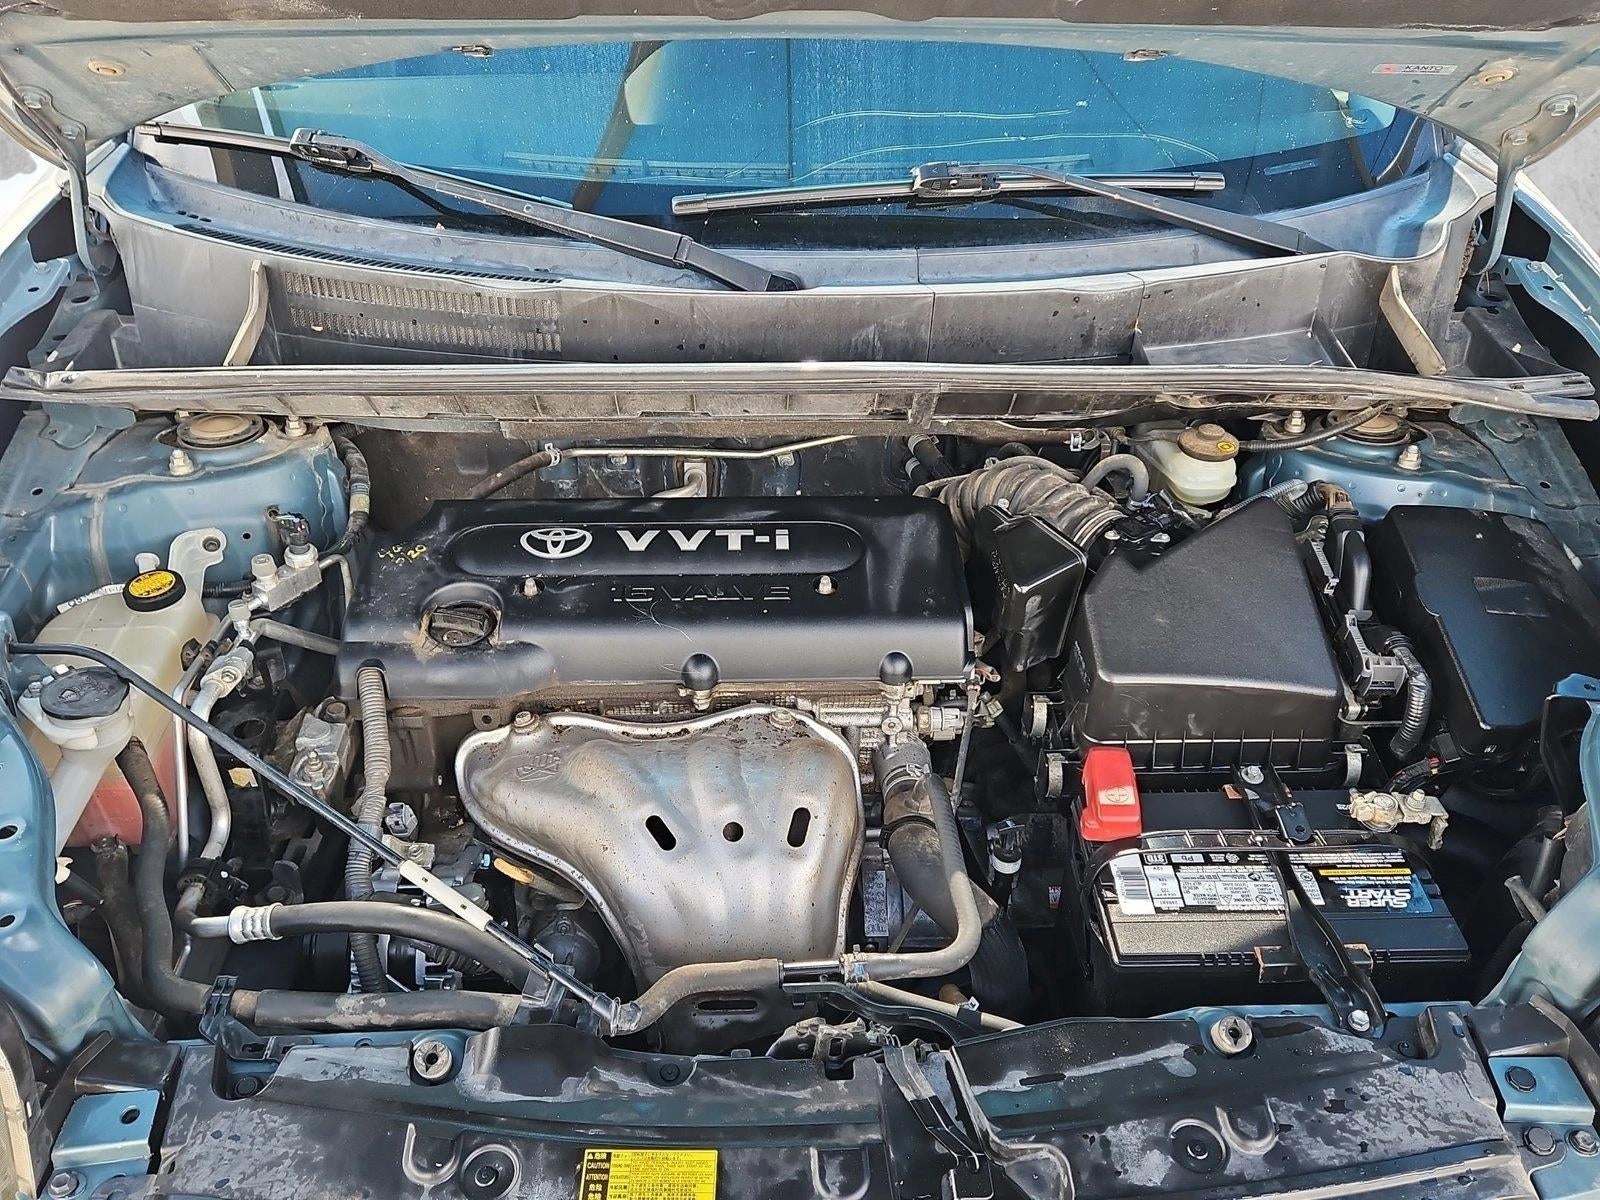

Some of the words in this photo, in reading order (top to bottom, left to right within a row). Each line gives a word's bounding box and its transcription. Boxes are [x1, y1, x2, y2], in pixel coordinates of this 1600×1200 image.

[616, 529, 790, 551] VVT-i
[1343, 888, 1411, 900] START
[1346, 898, 1408, 908] SUPER
[585, 1173, 609, 1181] ATTENTION
